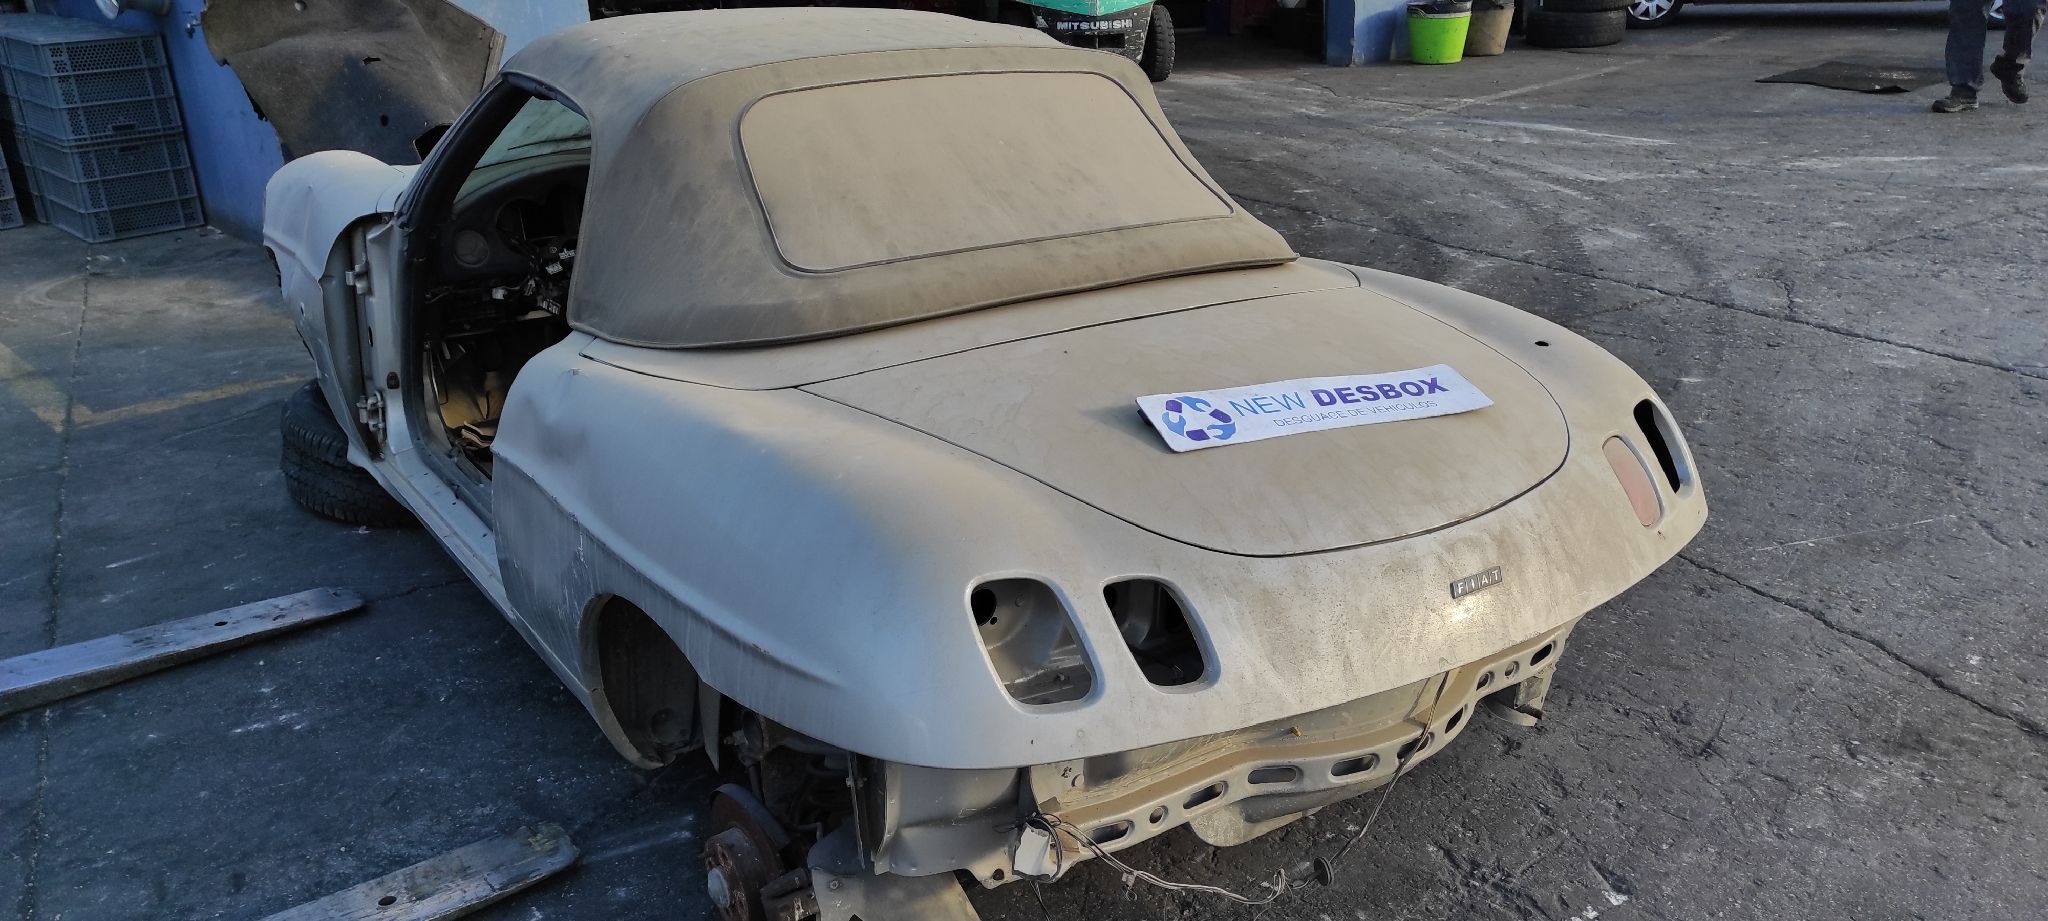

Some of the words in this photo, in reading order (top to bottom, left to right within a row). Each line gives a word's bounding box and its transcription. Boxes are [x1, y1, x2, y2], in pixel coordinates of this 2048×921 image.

[1056, 19, 1133, 30] MITSUBISHI
[1229, 391, 1305, 417] NEW
[1311, 377, 1450, 407] DESBOX
[1273, 410, 1348, 427] DESGUACE
[1348, 407, 1367, 417] DE
[1457, 570, 1498, 594] FIAT
